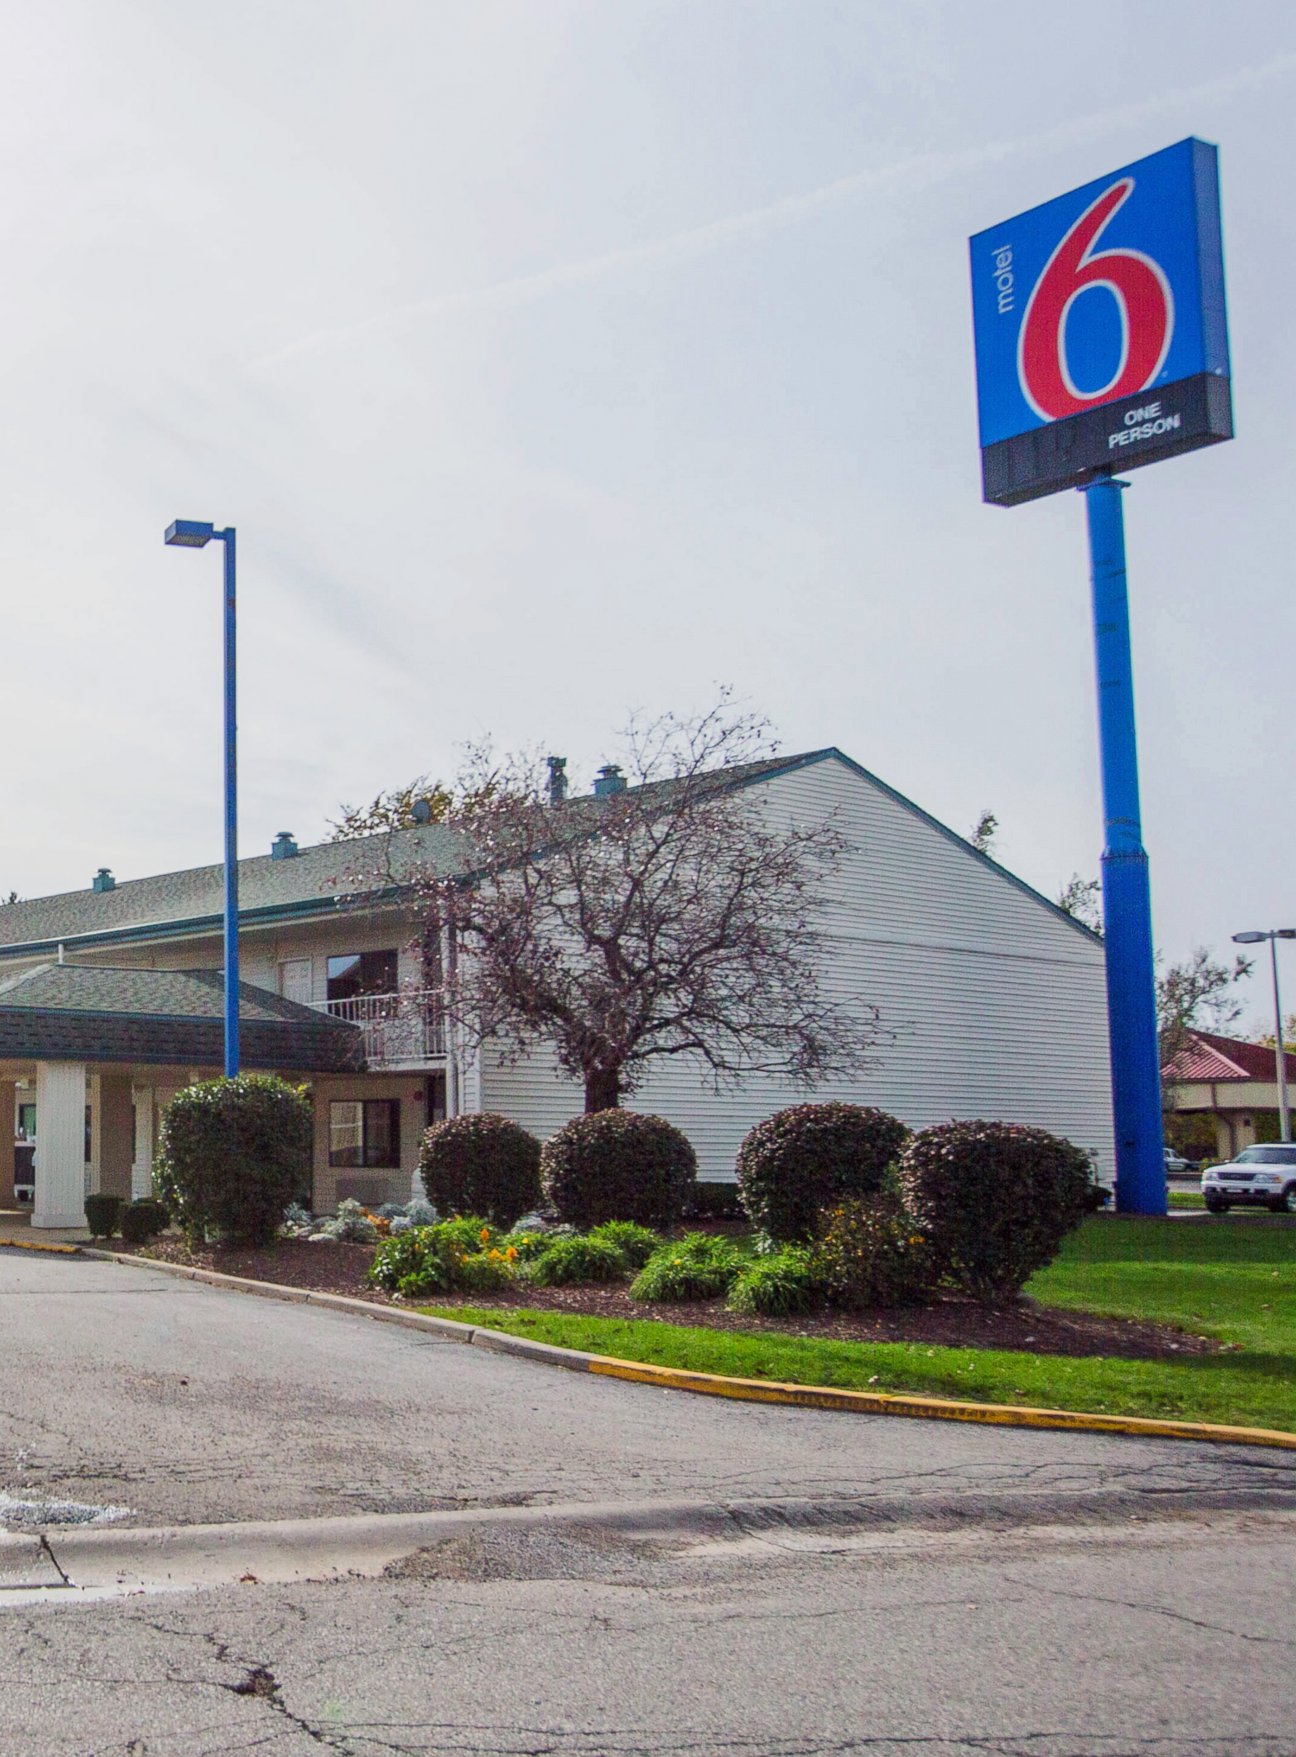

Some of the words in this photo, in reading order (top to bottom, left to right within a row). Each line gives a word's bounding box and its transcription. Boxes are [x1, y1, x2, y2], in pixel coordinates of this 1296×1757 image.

[991, 244, 1015, 314] motel
[1016, 176, 1175, 423] 6
[1108, 413, 1181, 449] PERSON
[1124, 401, 1161, 426] ONE
